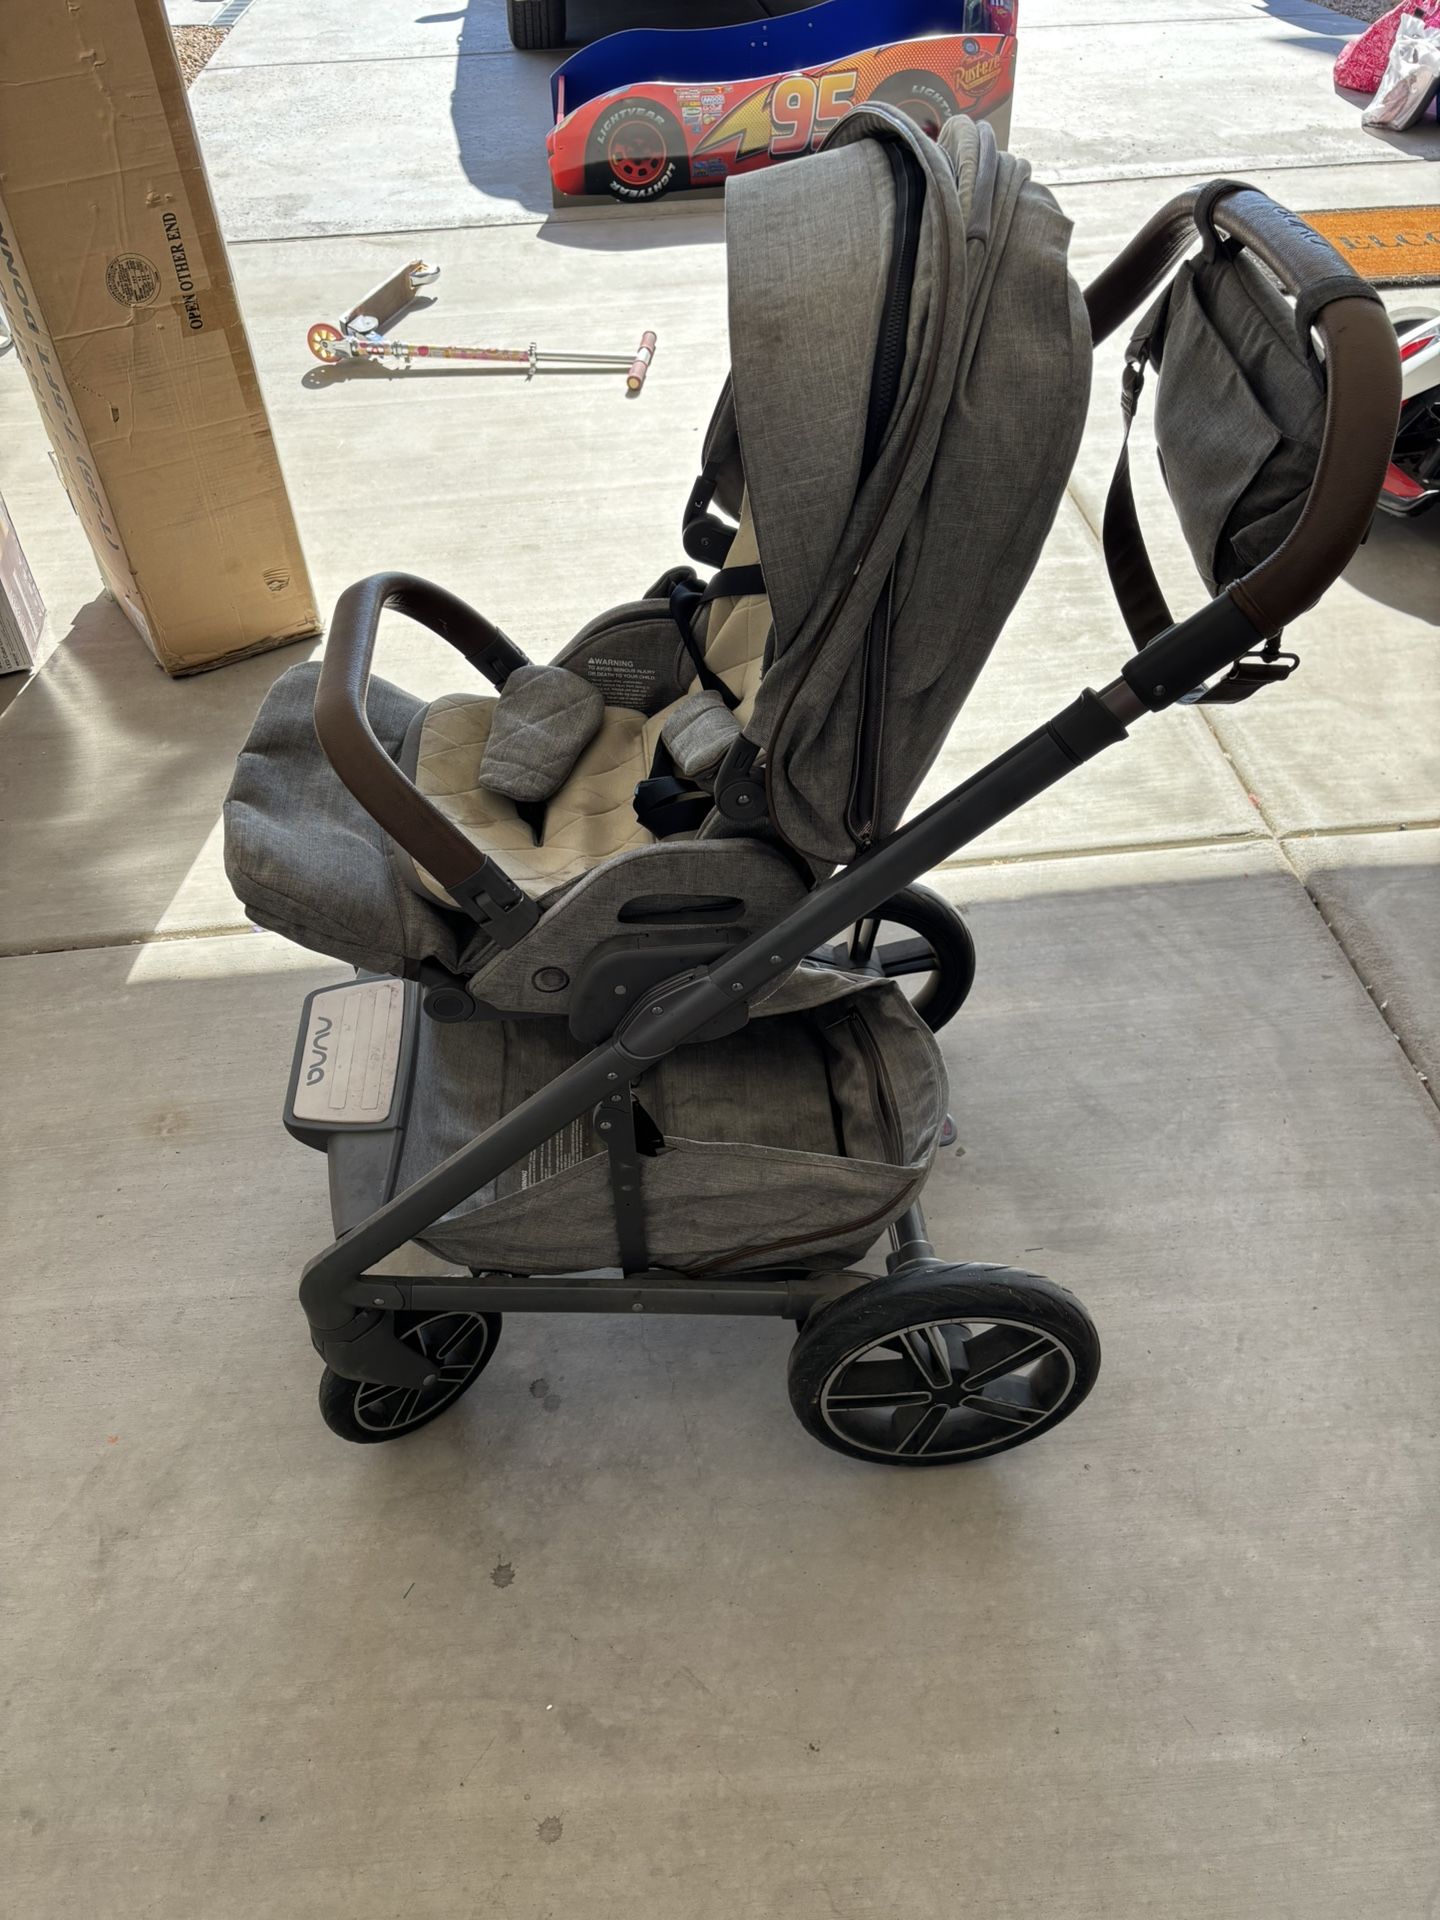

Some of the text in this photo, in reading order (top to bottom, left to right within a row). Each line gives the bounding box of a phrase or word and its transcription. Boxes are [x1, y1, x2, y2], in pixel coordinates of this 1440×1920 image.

[770, 70, 859, 156] 95
[912, 84, 953, 117] LIGHTY
[597, 106, 665, 145] LIGHTYEAR
[609, 162, 676, 198] LIGHTYEAR
[162, 212, 204, 331] OPEN OTHER END
[595, 657, 634, 667] WARNING
[306, 1016, 333, 1087] nuna
